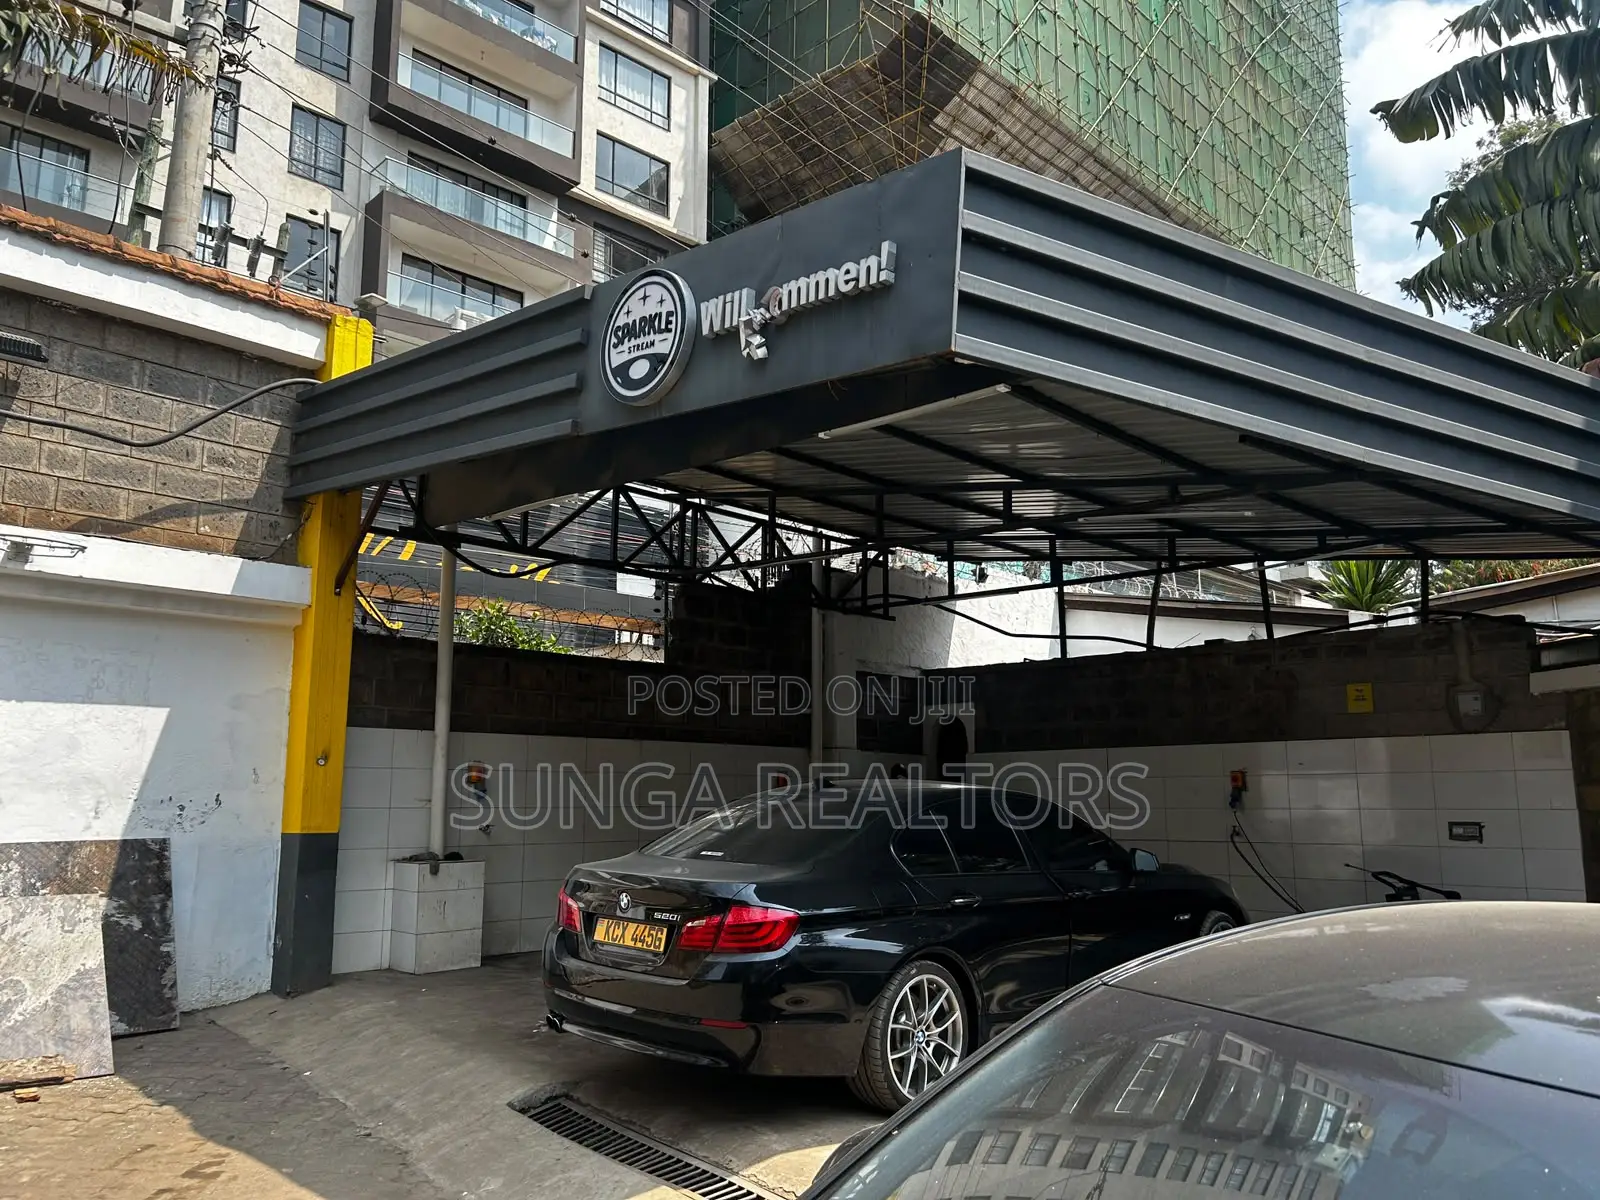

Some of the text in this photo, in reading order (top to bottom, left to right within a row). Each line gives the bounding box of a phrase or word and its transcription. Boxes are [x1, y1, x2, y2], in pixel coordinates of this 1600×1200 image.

[612, 310, 674, 349] SPARKLE
[627, 339, 656, 354] STREAM
[603, 920, 664, 949] KCX 445G
